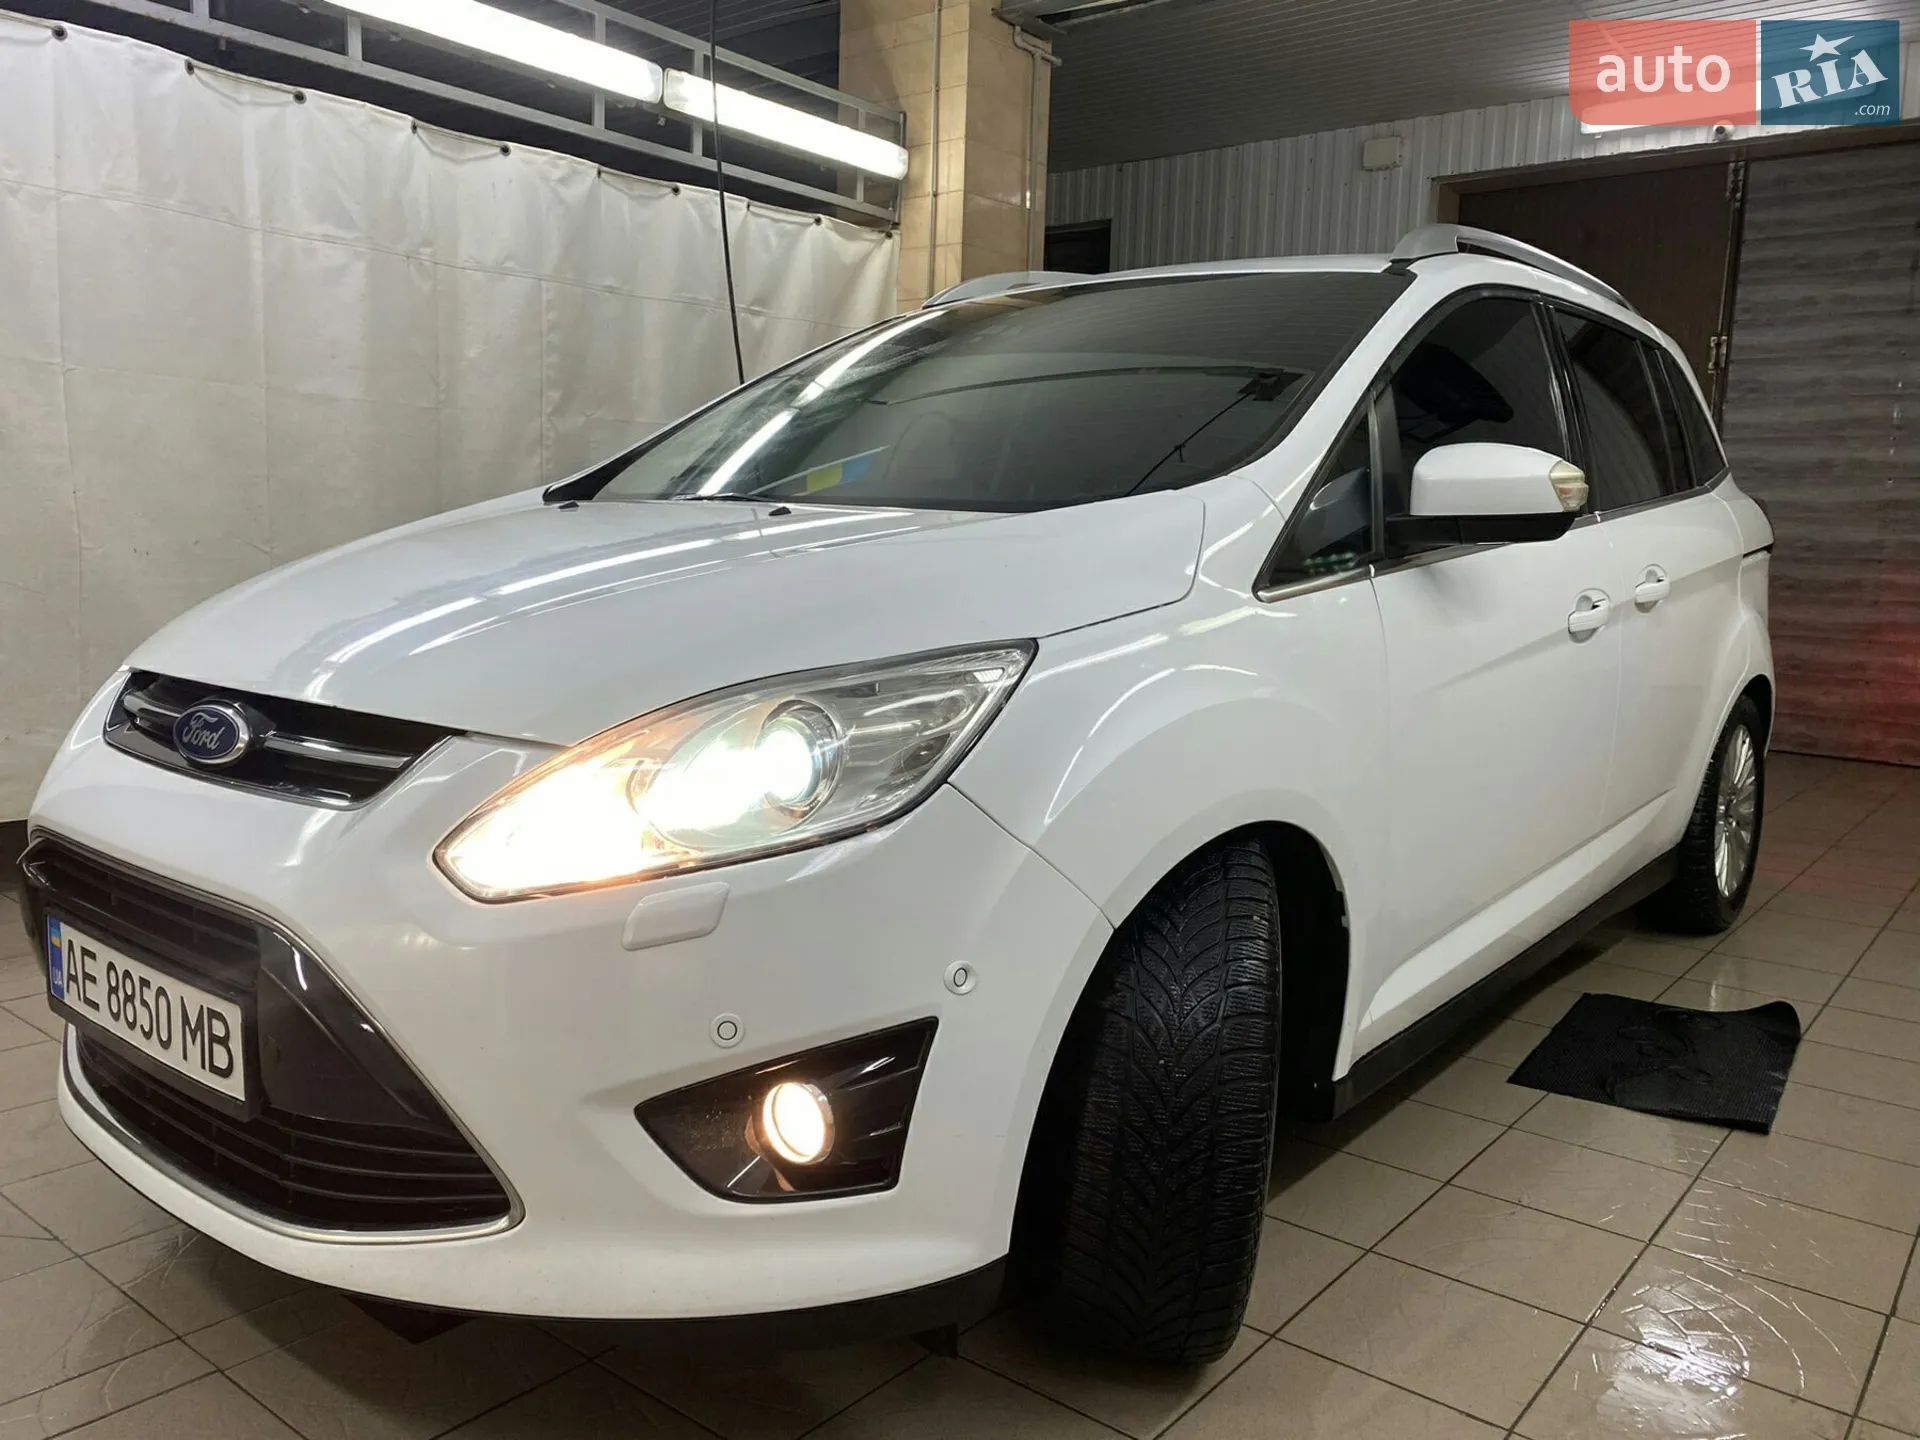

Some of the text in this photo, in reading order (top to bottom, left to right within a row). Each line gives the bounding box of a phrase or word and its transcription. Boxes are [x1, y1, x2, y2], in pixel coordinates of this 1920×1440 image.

[182, 711, 226, 750] Ford
[66, 939, 234, 1079] AE 8850 MB
